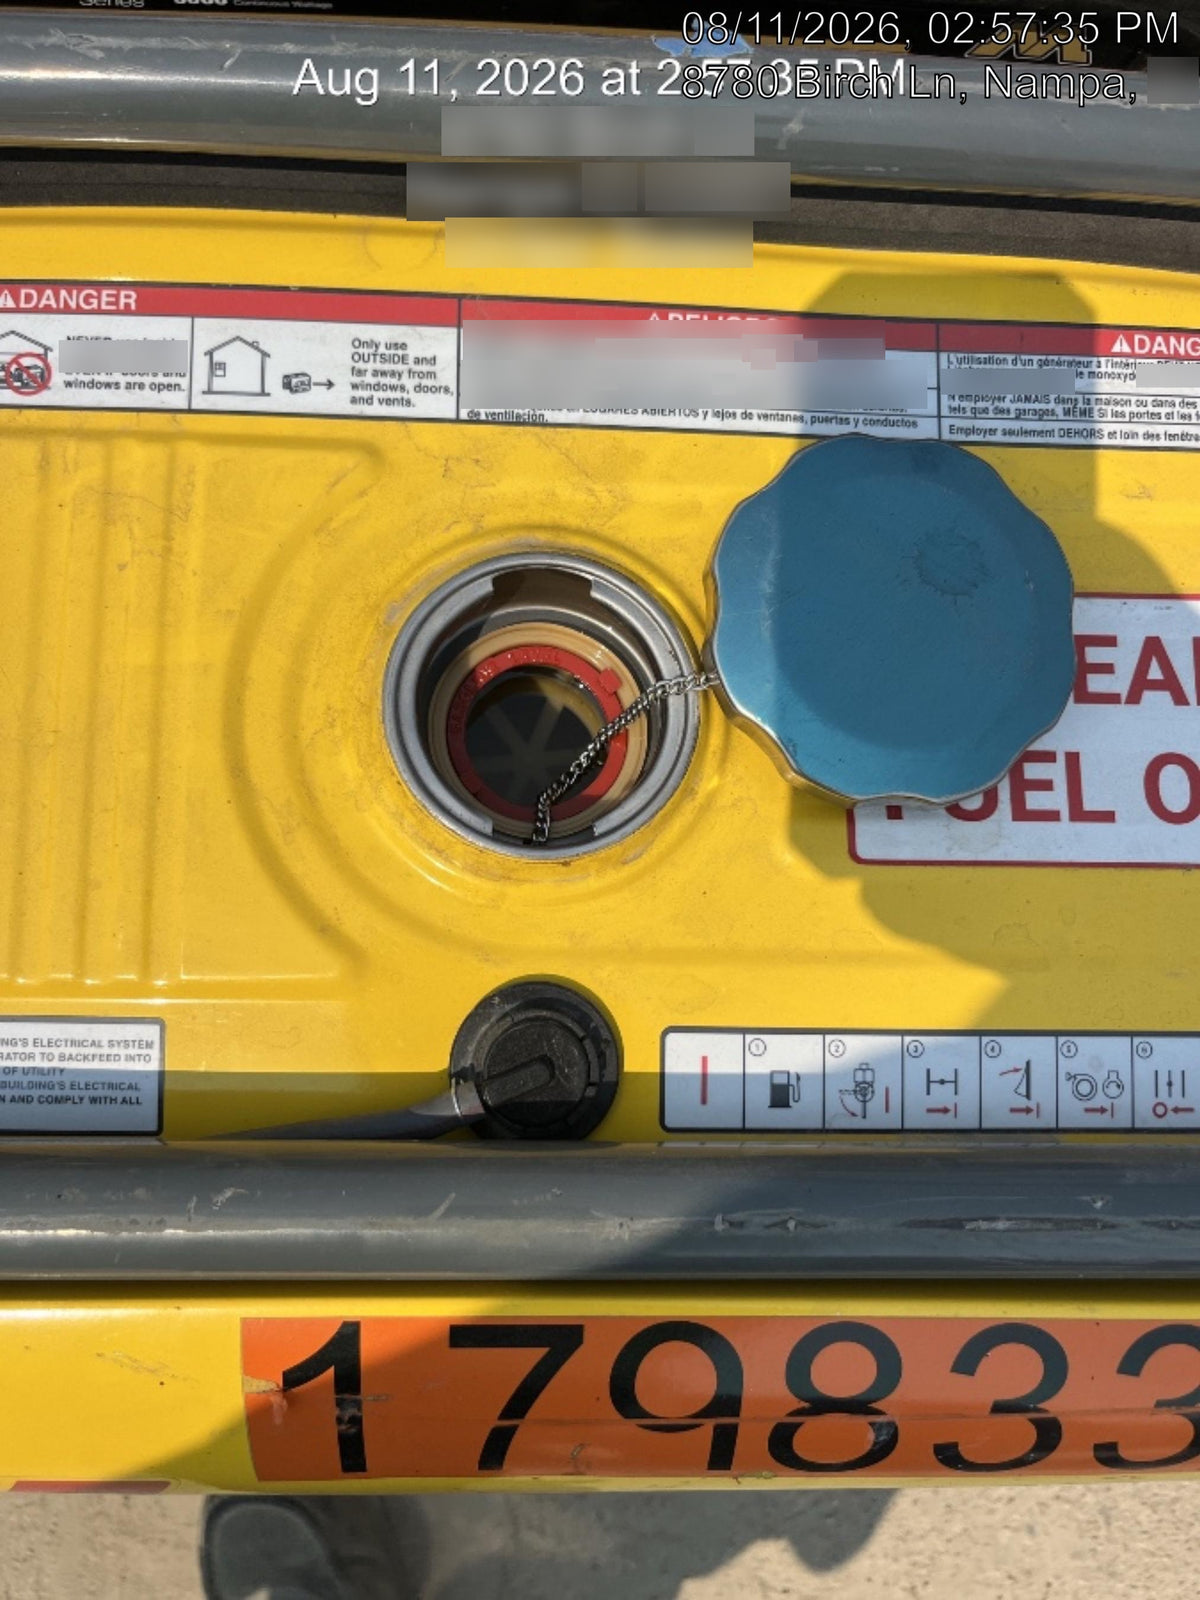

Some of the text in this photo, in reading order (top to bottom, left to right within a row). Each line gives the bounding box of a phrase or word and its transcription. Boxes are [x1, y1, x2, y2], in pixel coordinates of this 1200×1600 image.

[20, 289, 138, 310] DANGER
[351, 337, 408, 352] Only use
[1134, 333, 1200, 357] DANG
[351, 351, 437, 366] OUTSIDE and
[351, 366, 437, 381] far away from
[64, 379, 186, 394] windows are open.
[350, 380, 454, 396] windows, doors,
[350, 394, 416, 408] and vents.
[467, 409, 481, 420] de
[702, 410, 709, 420] y
[711, 409, 737, 421] lejos
[741, 410, 753, 420] de
[810, 414, 850, 426] puertas
[852, 417, 859, 428] y
[862, 417, 918, 429] conductos
[1128, 409, 1162, 422] portes
[948, 424, 998, 438] Employer
[1001, 427, 1055, 438] seulement
[1058, 428, 1105, 440] DEHORS
[33, 1037, 104, 1048] ELECTRICAL
[108, 1039, 154, 1050] SYSTEM
[39, 1052, 55, 1062] TO
[58, 1052, 122, 1063] BACKFEED
[124, 1053, 152, 1063] INTO
[2, 1066, 65, 1077] OF UTILITY
[70, 1081, 140, 1091] ELECTRICAL
[10, 1095, 34, 1105] AND
[37, 1095, 85, 1106] COMPLY
[88, 1096, 118, 1106] WITH
[120, 1096, 142, 1106] ALL
